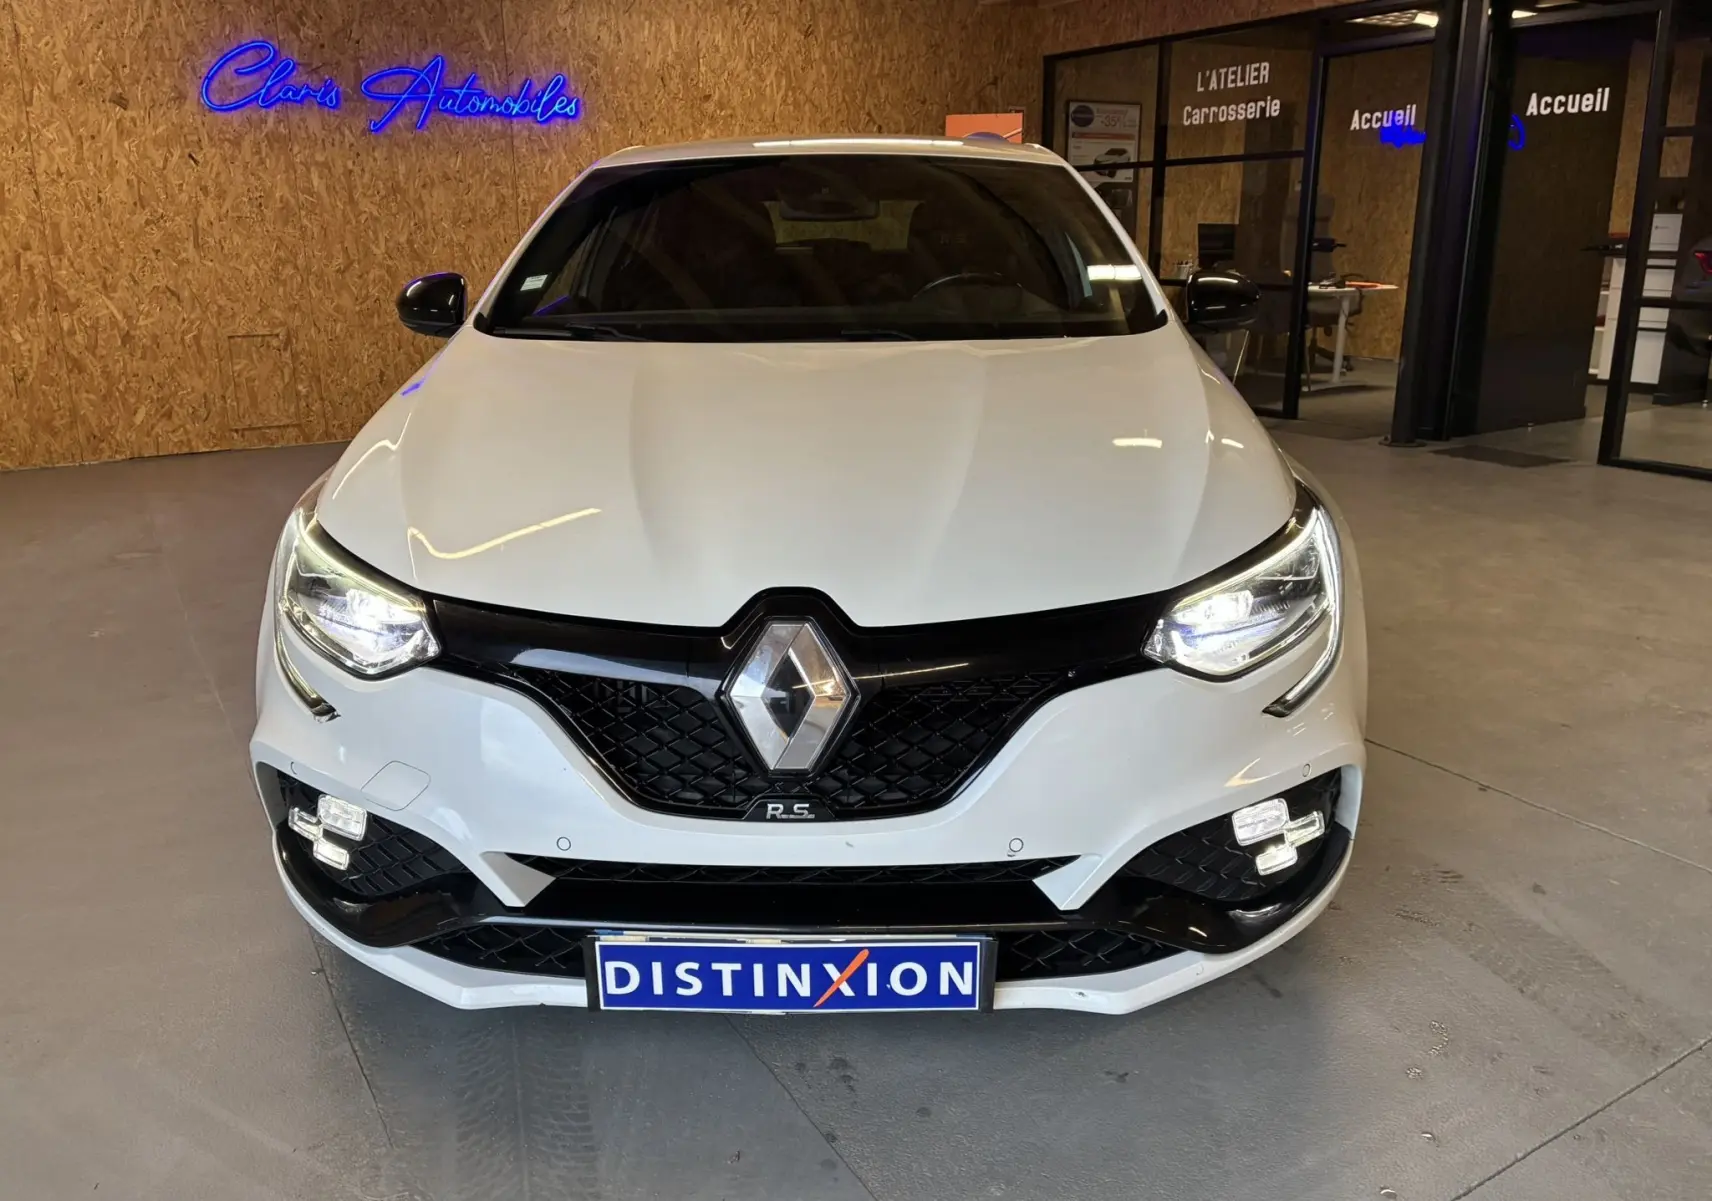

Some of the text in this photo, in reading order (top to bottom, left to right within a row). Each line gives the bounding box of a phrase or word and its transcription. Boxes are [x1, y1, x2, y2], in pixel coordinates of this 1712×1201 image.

[202, 40, 580, 133] Claris Automobiles
[1197, 61, 1270, 92] L'ATELIER
[1183, 96, 1281, 126] Carrosserie
[1526, 87, 1610, 116] Accueil
[1350, 104, 1417, 131] Accueil
[604, 949, 973, 1007] DISTINXION
